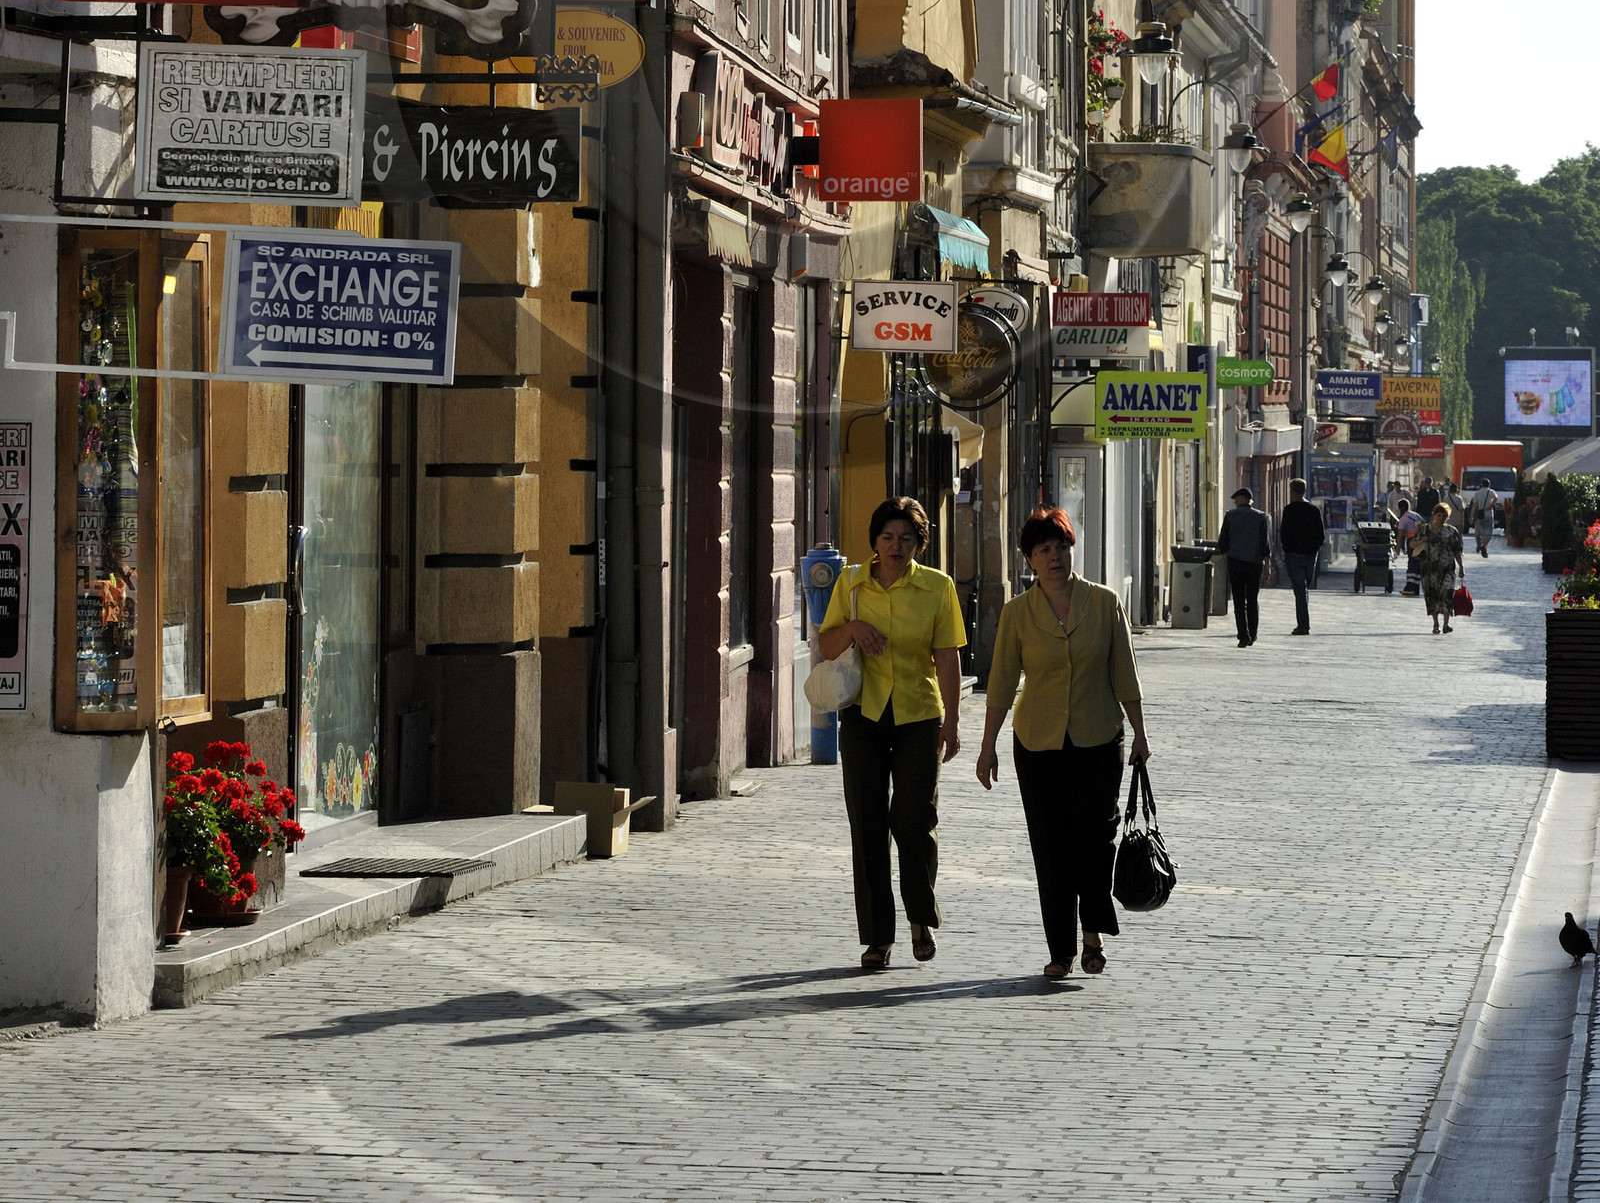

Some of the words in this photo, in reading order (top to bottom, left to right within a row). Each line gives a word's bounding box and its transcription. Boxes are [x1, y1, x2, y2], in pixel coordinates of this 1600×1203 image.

[568, 26, 626, 42] SOUVENIRS
[563, 44, 587, 56] FROM
[162, 58, 345, 91] REUMPLERI
[159, 87, 191, 113] SI
[203, 90, 342, 118] VANZARI
[170, 117, 331, 148] CARTUSE
[221, 153, 241, 163] din
[244, 154, 282, 164] Marea
[285, 156, 335, 166] Britanie
[418, 122, 557, 198] Piercing
[204, 164, 240, 174] Toner
[242, 166, 261, 175] din
[264, 167, 307, 176] Elvetia
[165, 175, 331, 192] www.euro-tel.ro
[823, 177, 909, 198] orange
[257, 245, 284, 257] SC
[290, 247, 391, 263] ANDRADA
[397, 253, 434, 265] SRL
[250, 261, 439, 308] EXCHANGE
[249, 301, 290, 319] CASA
[296, 303, 314, 319] DE
[321, 305, 373, 323] SCHIMB
[379, 308, 437, 326] VALUTAR
[855, 291, 951, 318] SERVICE
[1057, 296, 1093, 322] AGENTIE
[1097, 296, 1109, 322] DE
[1113, 296, 1147, 323] TURISM
[248, 324, 388, 348] COMISION:
[393, 331, 435, 351] 0%
[874, 322, 933, 341] GSM
[1056, 328, 1128, 345] CARLIDA
[1219, 367, 1272, 379] COSMOTE
[1329, 376, 1369, 385] AMANET
[1322, 387, 1374, 396] EXCHANGE
[1388, 381, 1439, 393] TAVERNA
[1102, 382, 1202, 412] AMANET
[0, 450, 26, 467] RI
